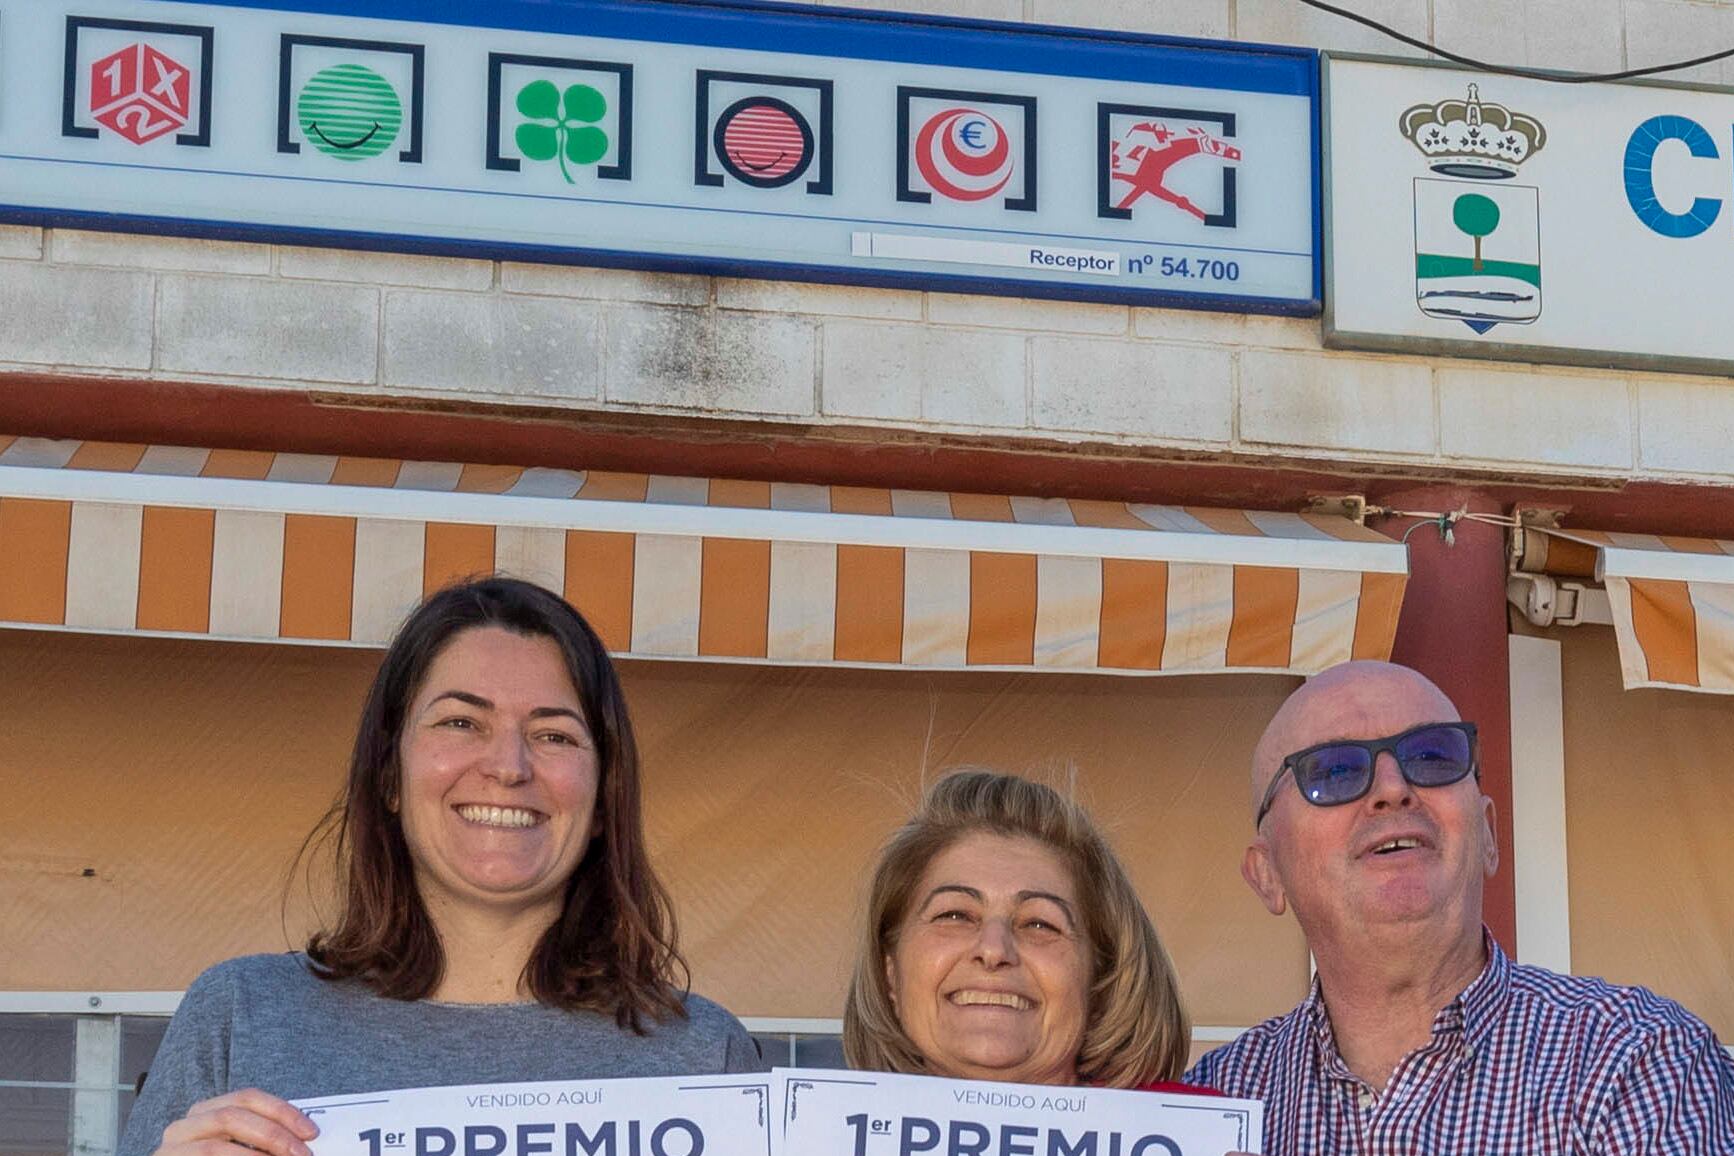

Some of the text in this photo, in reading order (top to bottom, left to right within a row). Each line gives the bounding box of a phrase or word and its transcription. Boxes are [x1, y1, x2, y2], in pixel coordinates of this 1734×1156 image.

[1029, 248, 1115, 273] Receptor
[1160, 255, 1240, 282] 54.700
[466, 1087, 603, 1108] VENDIDO AQUÍ
[952, 1089, 1087, 1113] VENDIDO AQUÍ
